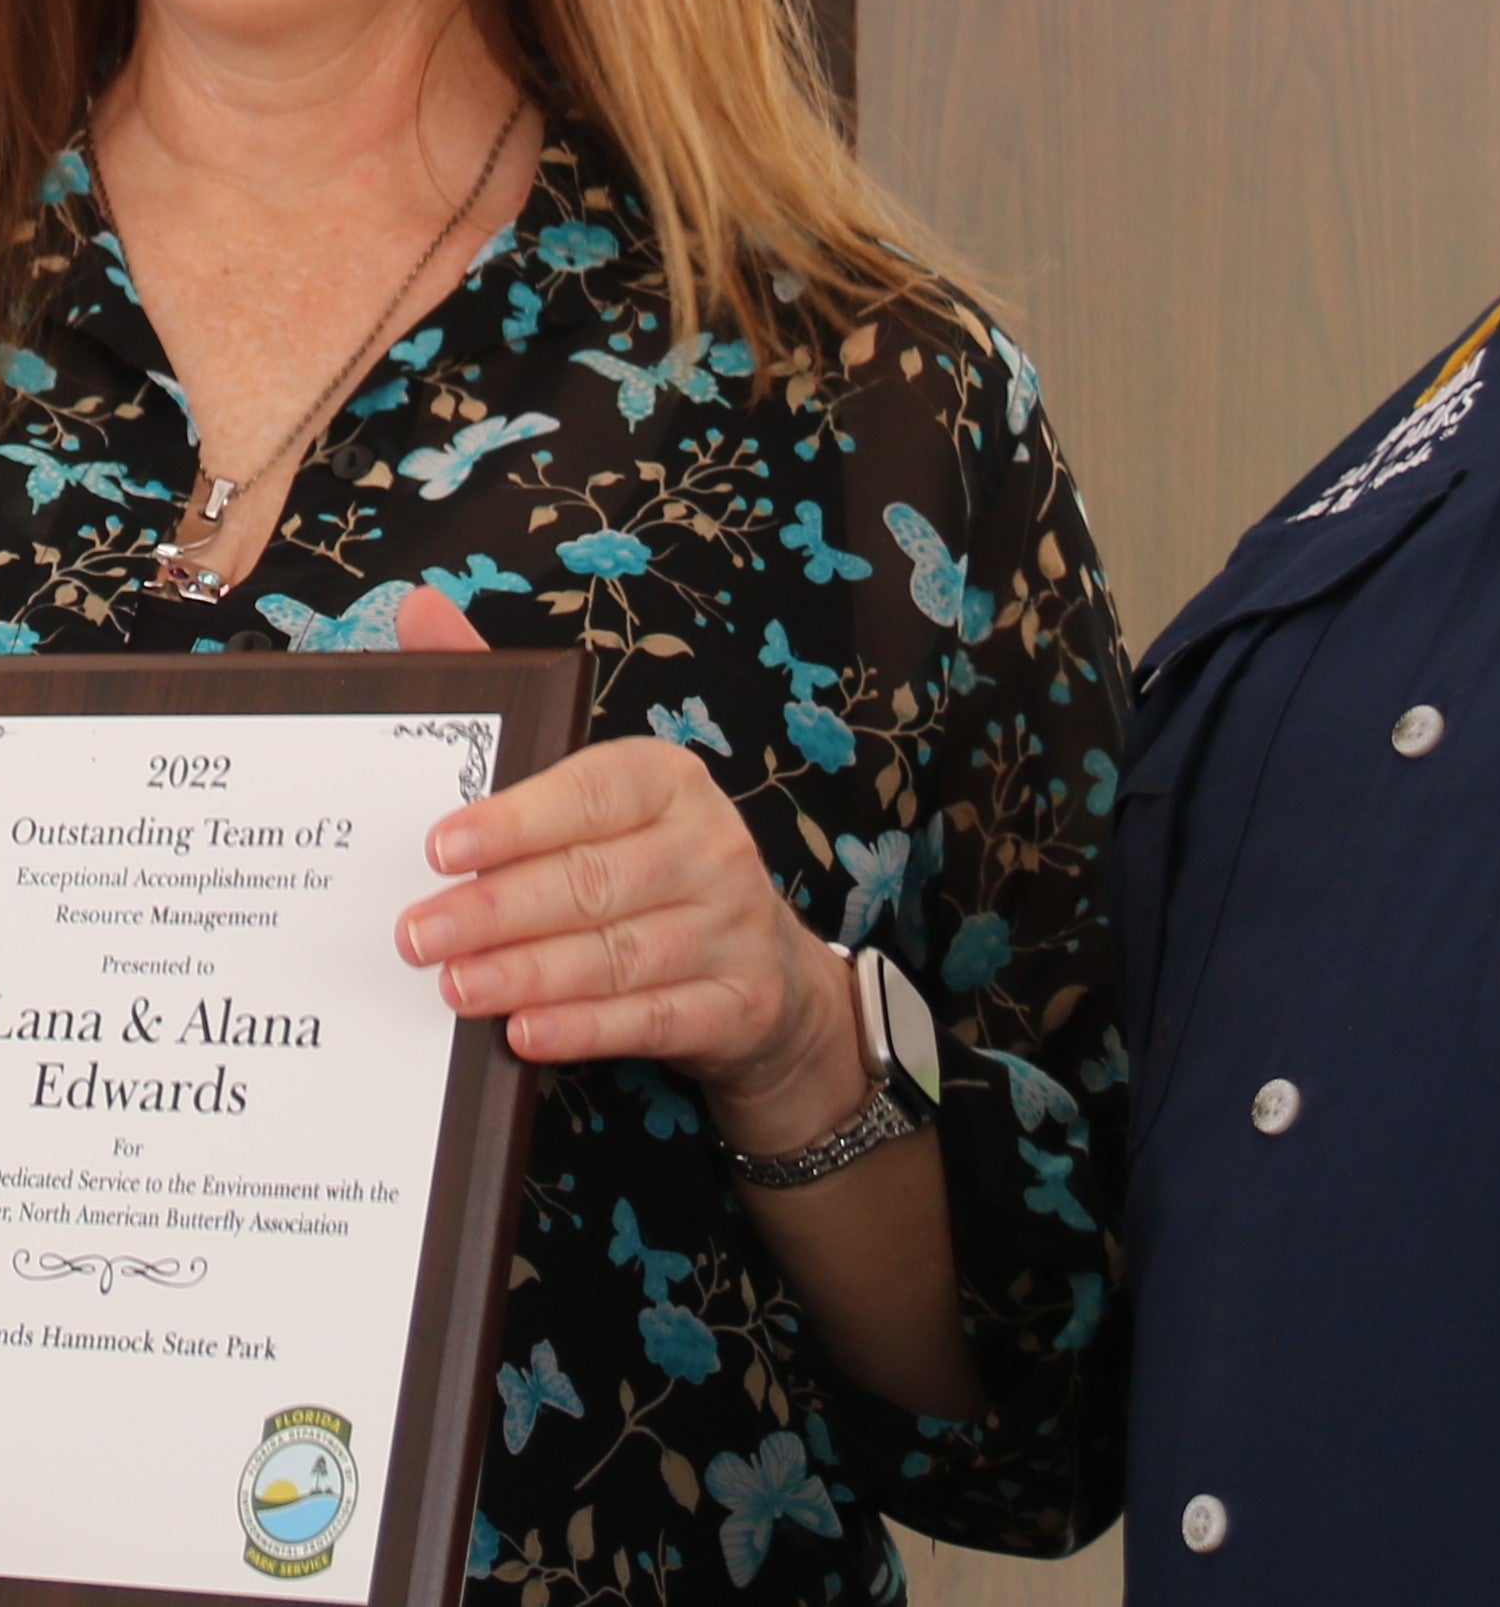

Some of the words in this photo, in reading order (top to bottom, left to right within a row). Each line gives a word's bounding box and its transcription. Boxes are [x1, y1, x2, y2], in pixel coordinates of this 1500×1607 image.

[146, 754, 232, 791] 2022
[11, 815, 193, 857] Outstanding
[203, 817, 285, 848] Team
[294, 817, 330, 849] of
[333, 818, 353, 850] 2
[16, 866, 127, 894] Exceptional
[132, 867, 295, 896] Accomplishment
[302, 868, 333, 890] for
[55, 903, 144, 926] Resource
[150, 904, 279, 933] Management
[101, 954, 190, 976] Presented
[196, 958, 216, 976] to
[121, 995, 164, 1045] &
[174, 995, 322, 1050] Alana
[28, 1059, 248, 1116] Edwards
[112, 1137, 144, 1158] For
[77, 1169, 141, 1193] Service
[145, 1174, 164, 1194] to
[167, 1172, 197, 1196] the
[202, 1174, 321, 1201] Environment
[326, 1178, 364, 1203] with
[369, 1180, 400, 1204] the
[18, 1201, 71, 1225] North
[74, 1203, 160, 1228] American
[165, 1207, 245, 1238] Butterfly
[248, 1210, 349, 1237] Association
[41, 1324, 155, 1355] Hammock
[161, 1330, 219, 1358] State
[226, 1334, 277, 1362] Park
[274, 1409, 342, 1434] FLORIDA
[279, 1552, 330, 1578] SERVICE
